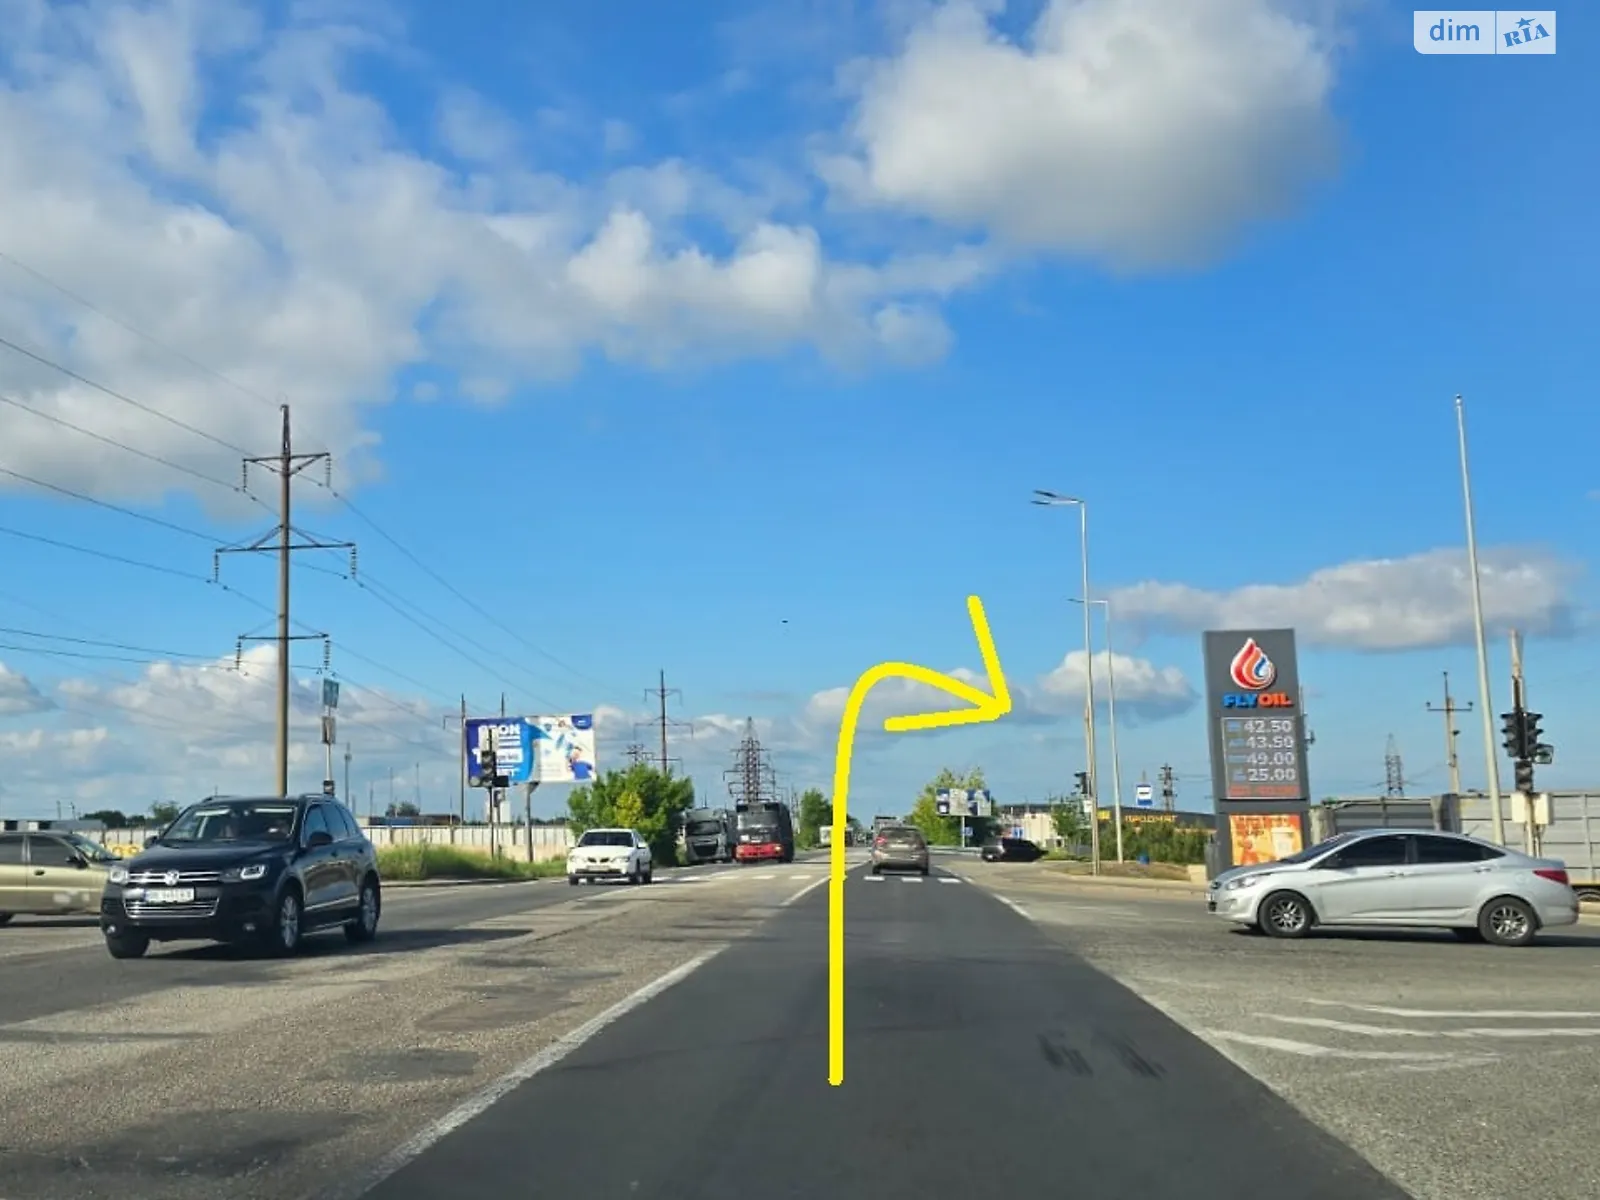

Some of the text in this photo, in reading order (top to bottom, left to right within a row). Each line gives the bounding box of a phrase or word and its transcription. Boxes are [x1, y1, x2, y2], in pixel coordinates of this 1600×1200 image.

[1244, 720, 1292, 733] 42.50
[1246, 736, 1294, 749] 43.50
[1248, 752, 1295, 765] 49.00
[1248, 768, 1296, 781] 25.00
